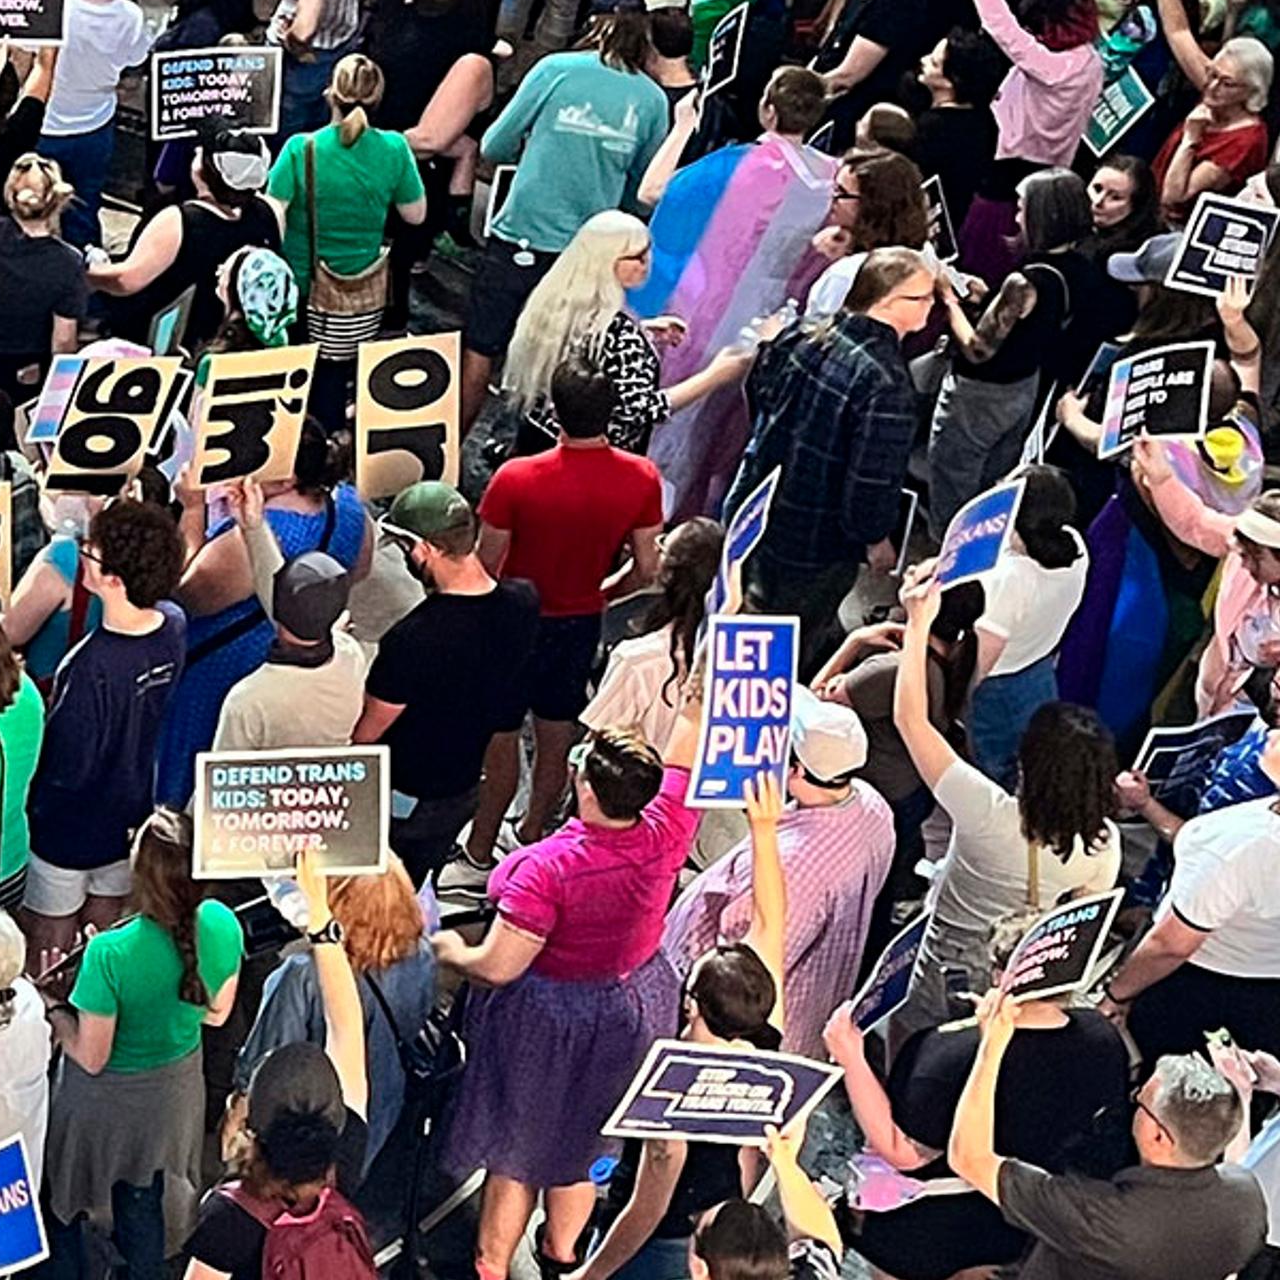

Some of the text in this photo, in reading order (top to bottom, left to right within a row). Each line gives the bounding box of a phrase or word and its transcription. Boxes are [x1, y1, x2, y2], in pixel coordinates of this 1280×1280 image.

[716, 630, 775, 671] LET
[712, 676, 788, 721] KIDS
[705, 724, 790, 767] PLAY
[212, 761, 366, 787] DEFEND TRANS
[212, 786, 350, 809] KIDS: TODAY,
[211, 809, 350, 833] TOMORROW,
[228, 830, 329, 853] FOREVER.
